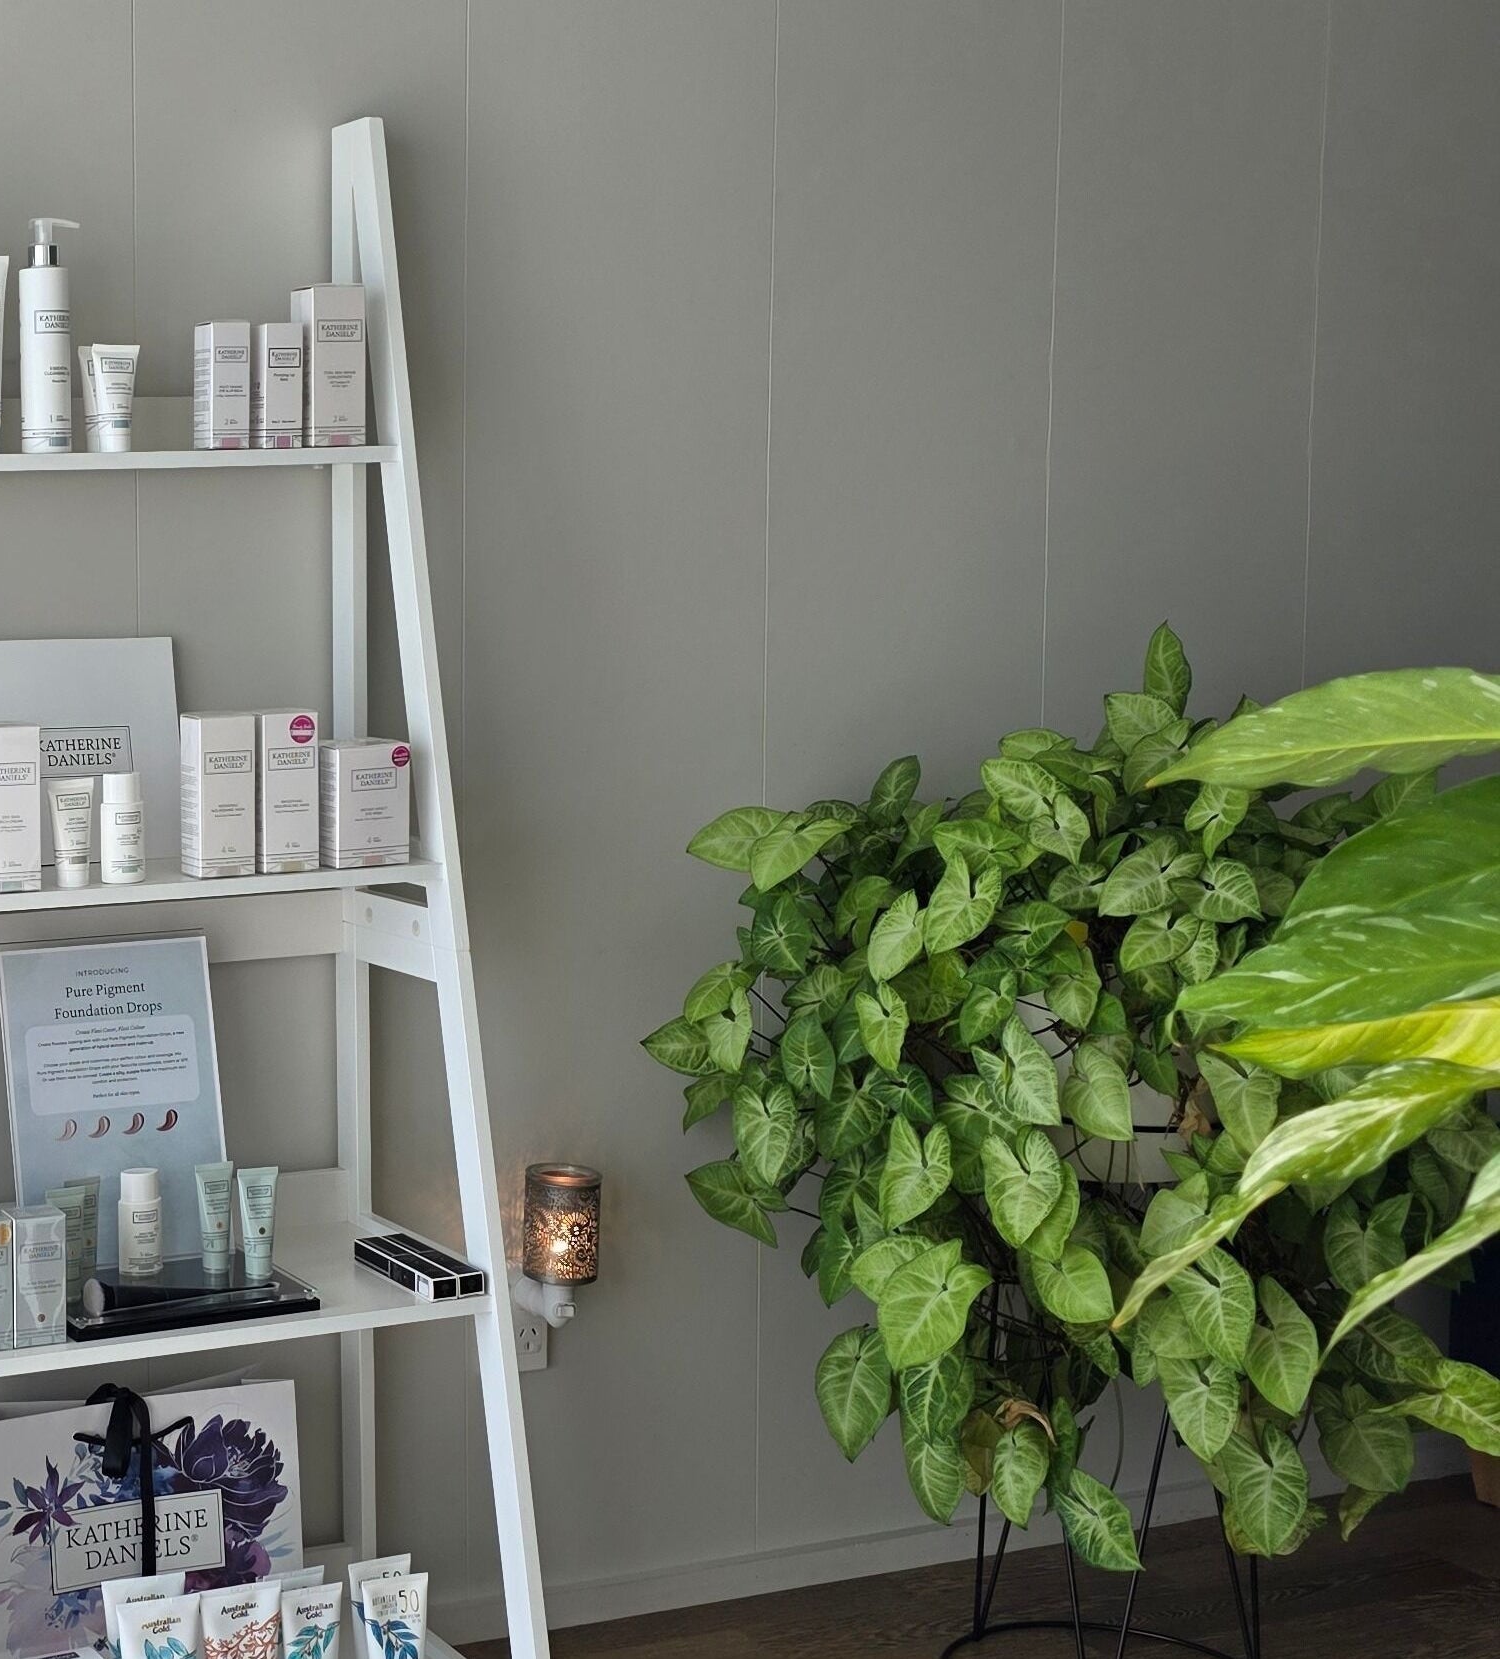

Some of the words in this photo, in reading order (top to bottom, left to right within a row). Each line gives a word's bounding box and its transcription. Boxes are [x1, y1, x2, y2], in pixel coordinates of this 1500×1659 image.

[272, 751, 311, 760] KATHERINE
[356, 772, 394, 780] KATHERINE
[75, 966, 130, 978] INTRODUCING
[65, 986, 93, 999] Pure
[96, 982, 146, 999] Pigment
[54, 1003, 124, 1020] Foundation
[127, 1000, 163, 1015] Drops
[398, 1589, 420, 1614] 50
[231, 1611, 249, 1620] Gold
[296, 1603, 334, 1616] Australian
[305, 1610, 322, 1620] Gold
[141, 1617, 181, 1629] Australian
[152, 1625, 171, 1634] Gold
